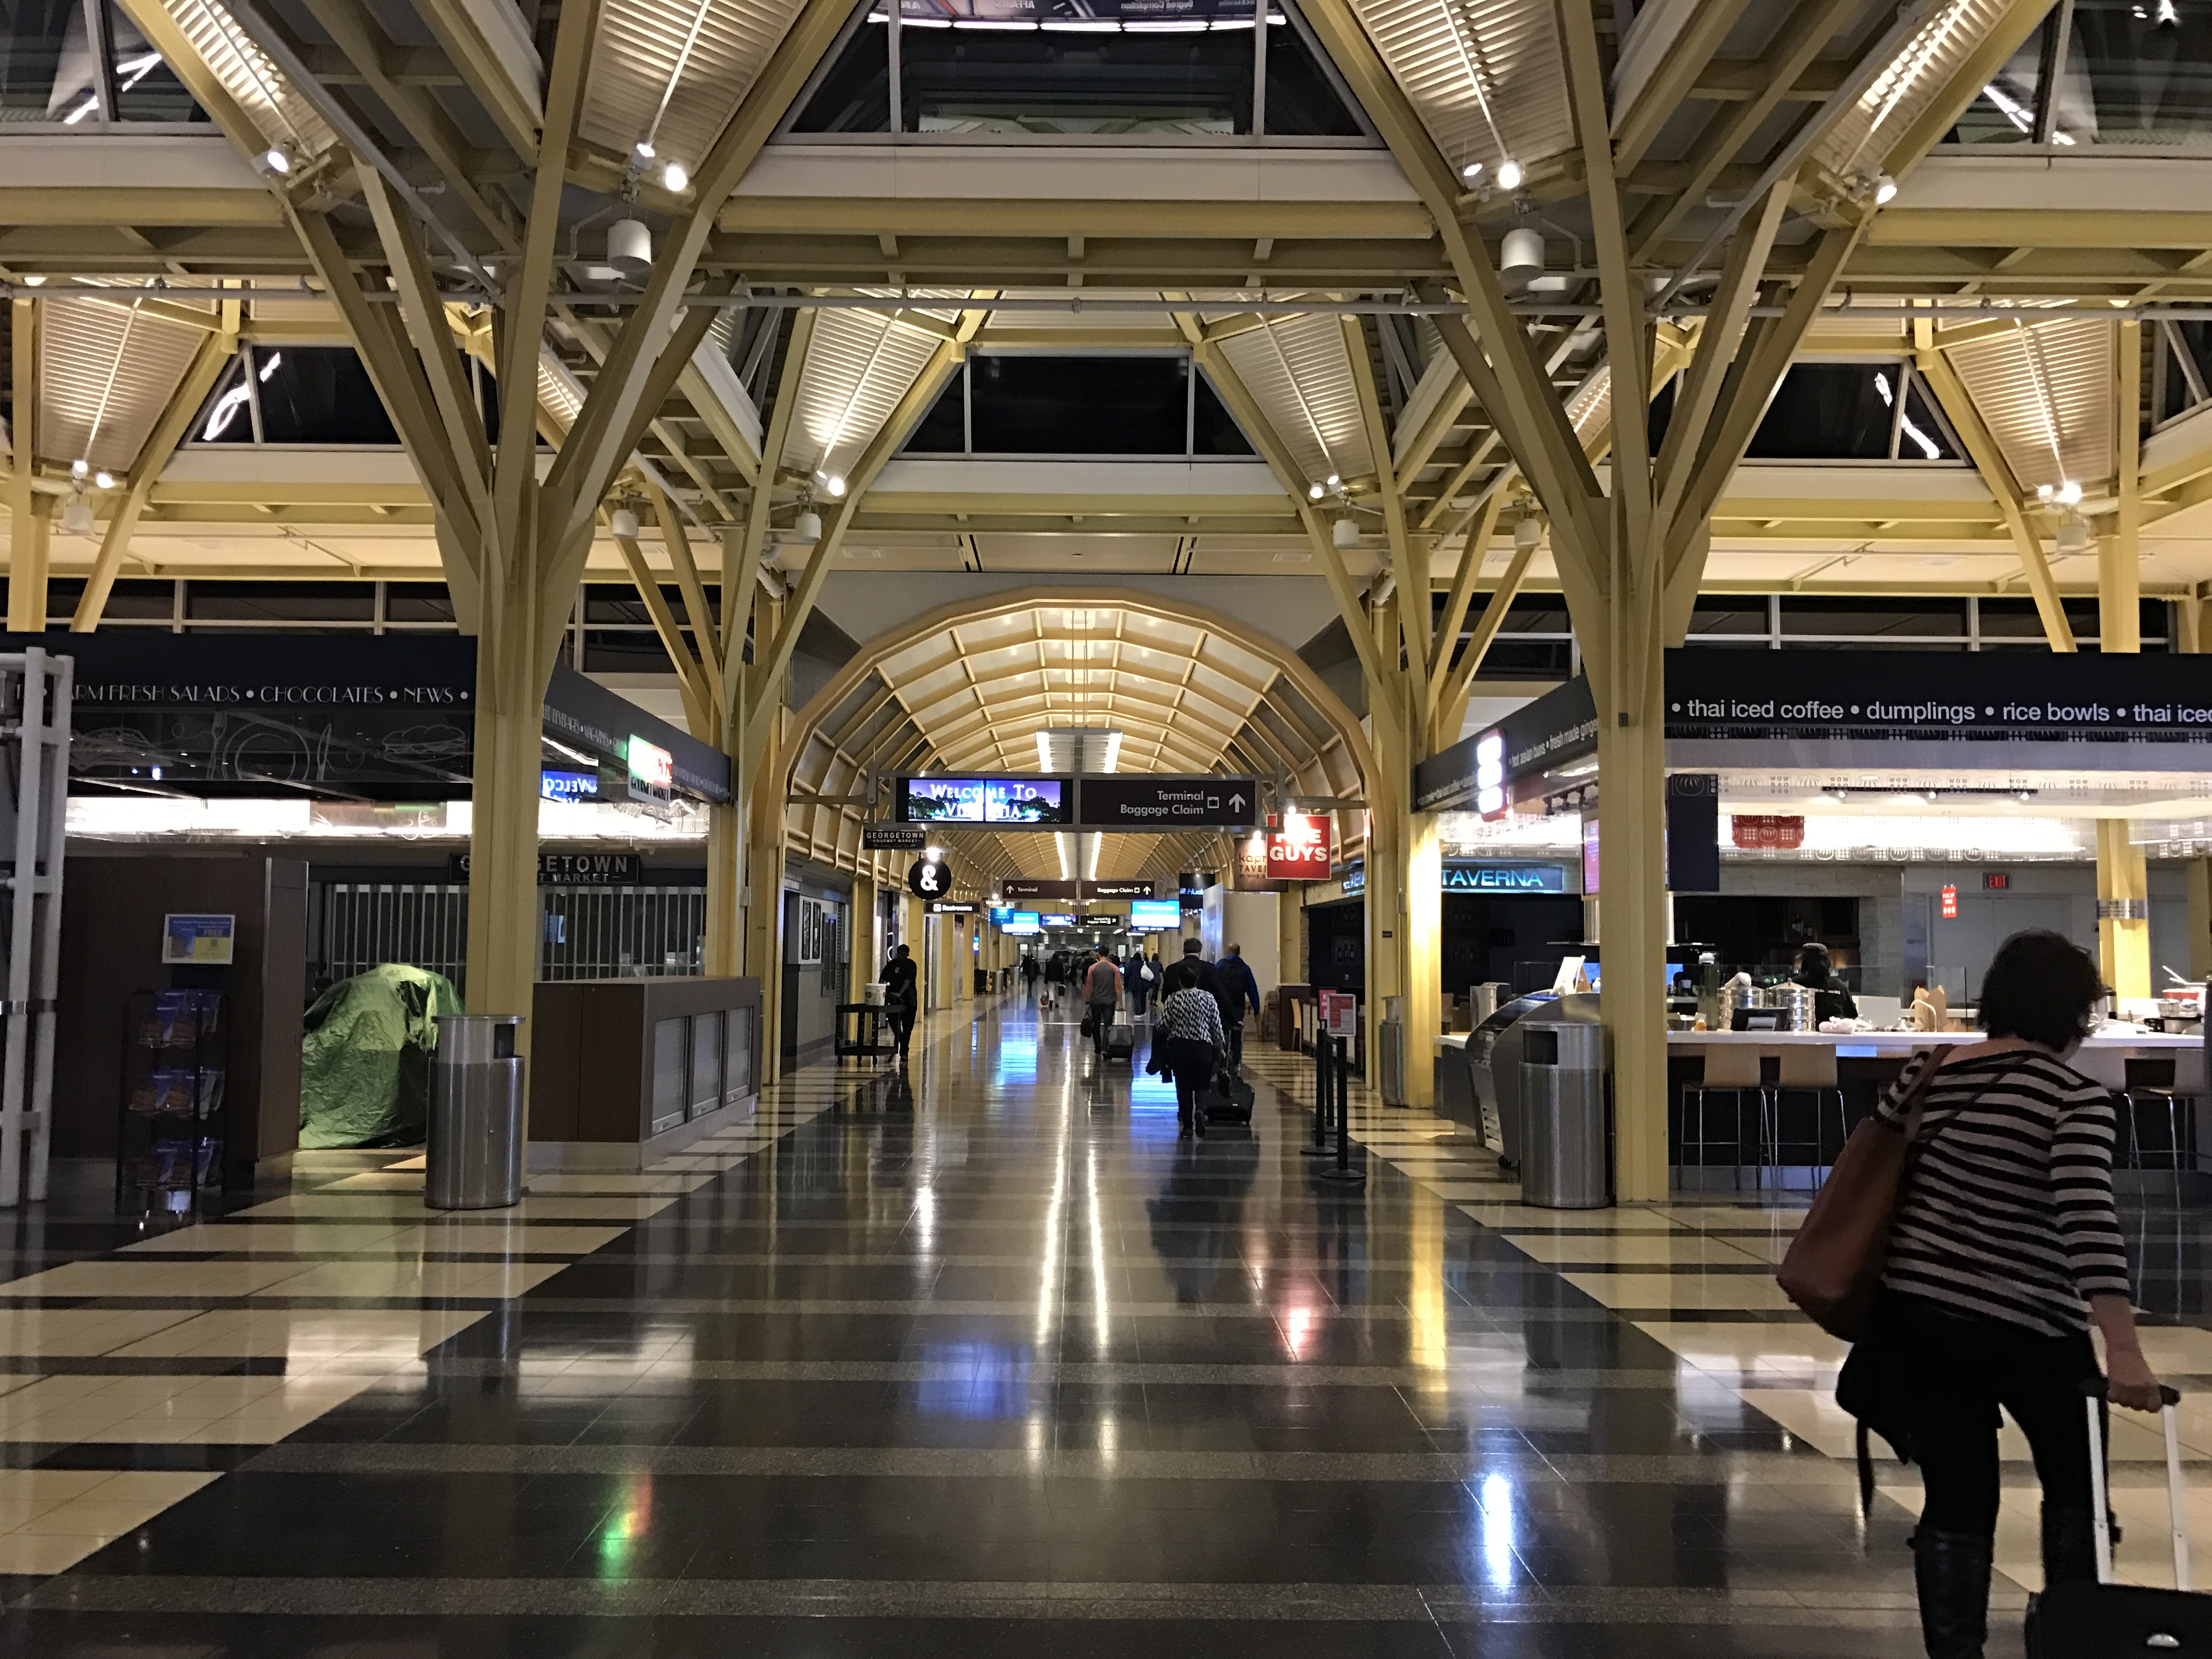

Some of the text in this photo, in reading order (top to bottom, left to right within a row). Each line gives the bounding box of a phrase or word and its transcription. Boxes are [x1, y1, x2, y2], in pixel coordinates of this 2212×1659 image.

[109, 685, 164, 701] FRESH
[169, 685, 240, 702] SALADS
[260, 686, 383, 703] CHOCOLATES
[403, 687, 454, 703] NEWS
[1688, 699, 1725, 718] thai
[1731, 699, 1774, 718] iced
[1780, 701, 1844, 719] coffee
[1866, 701, 1976, 724] dumplings
[2003, 702, 2041, 720] rice
[2047, 703, 2110, 721] bowls
[2132, 704, 2171, 723] thai
[1013, 785, 1037, 799] TO
[1156, 791, 1204, 801] Terminal
[944, 803, 1022, 819] VIIA
[1120, 804, 1204, 817] Baggage Claim
[1276, 828, 1322, 844] FE
[1269, 846, 1328, 862] GUYS
[552, 873, 609, 883] MARKET
[1441, 868, 1544, 887] TAVERNA
[1989, 874, 2006, 888] EXIT
